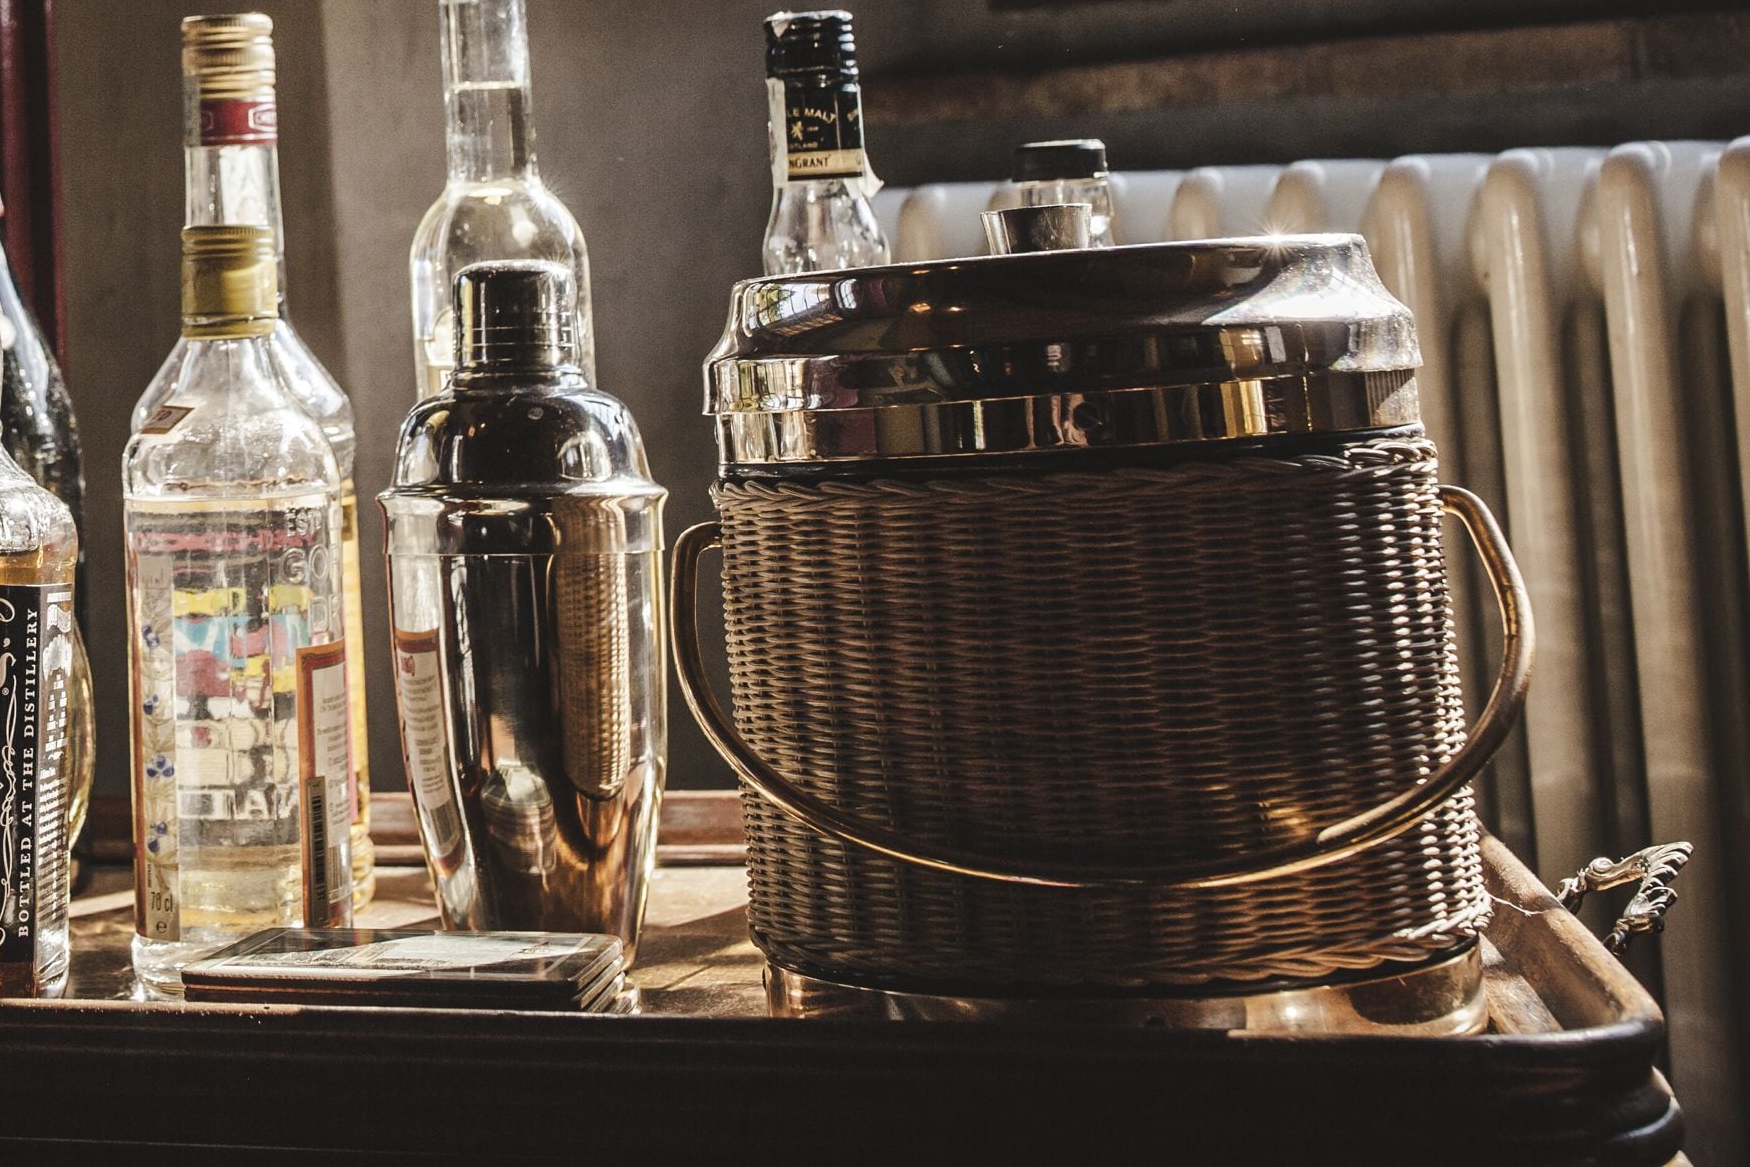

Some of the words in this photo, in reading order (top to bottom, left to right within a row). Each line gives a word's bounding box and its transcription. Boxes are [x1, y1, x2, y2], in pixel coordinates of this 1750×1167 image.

[804, 108, 837, 123] MALT
[788, 157, 828, 169] NGRANT
[23, 608, 38, 738] DISTILLERY
[22, 747, 34, 791] THE
[21, 801, 33, 826] AT
[18, 837, 32, 938] BOTTLED
